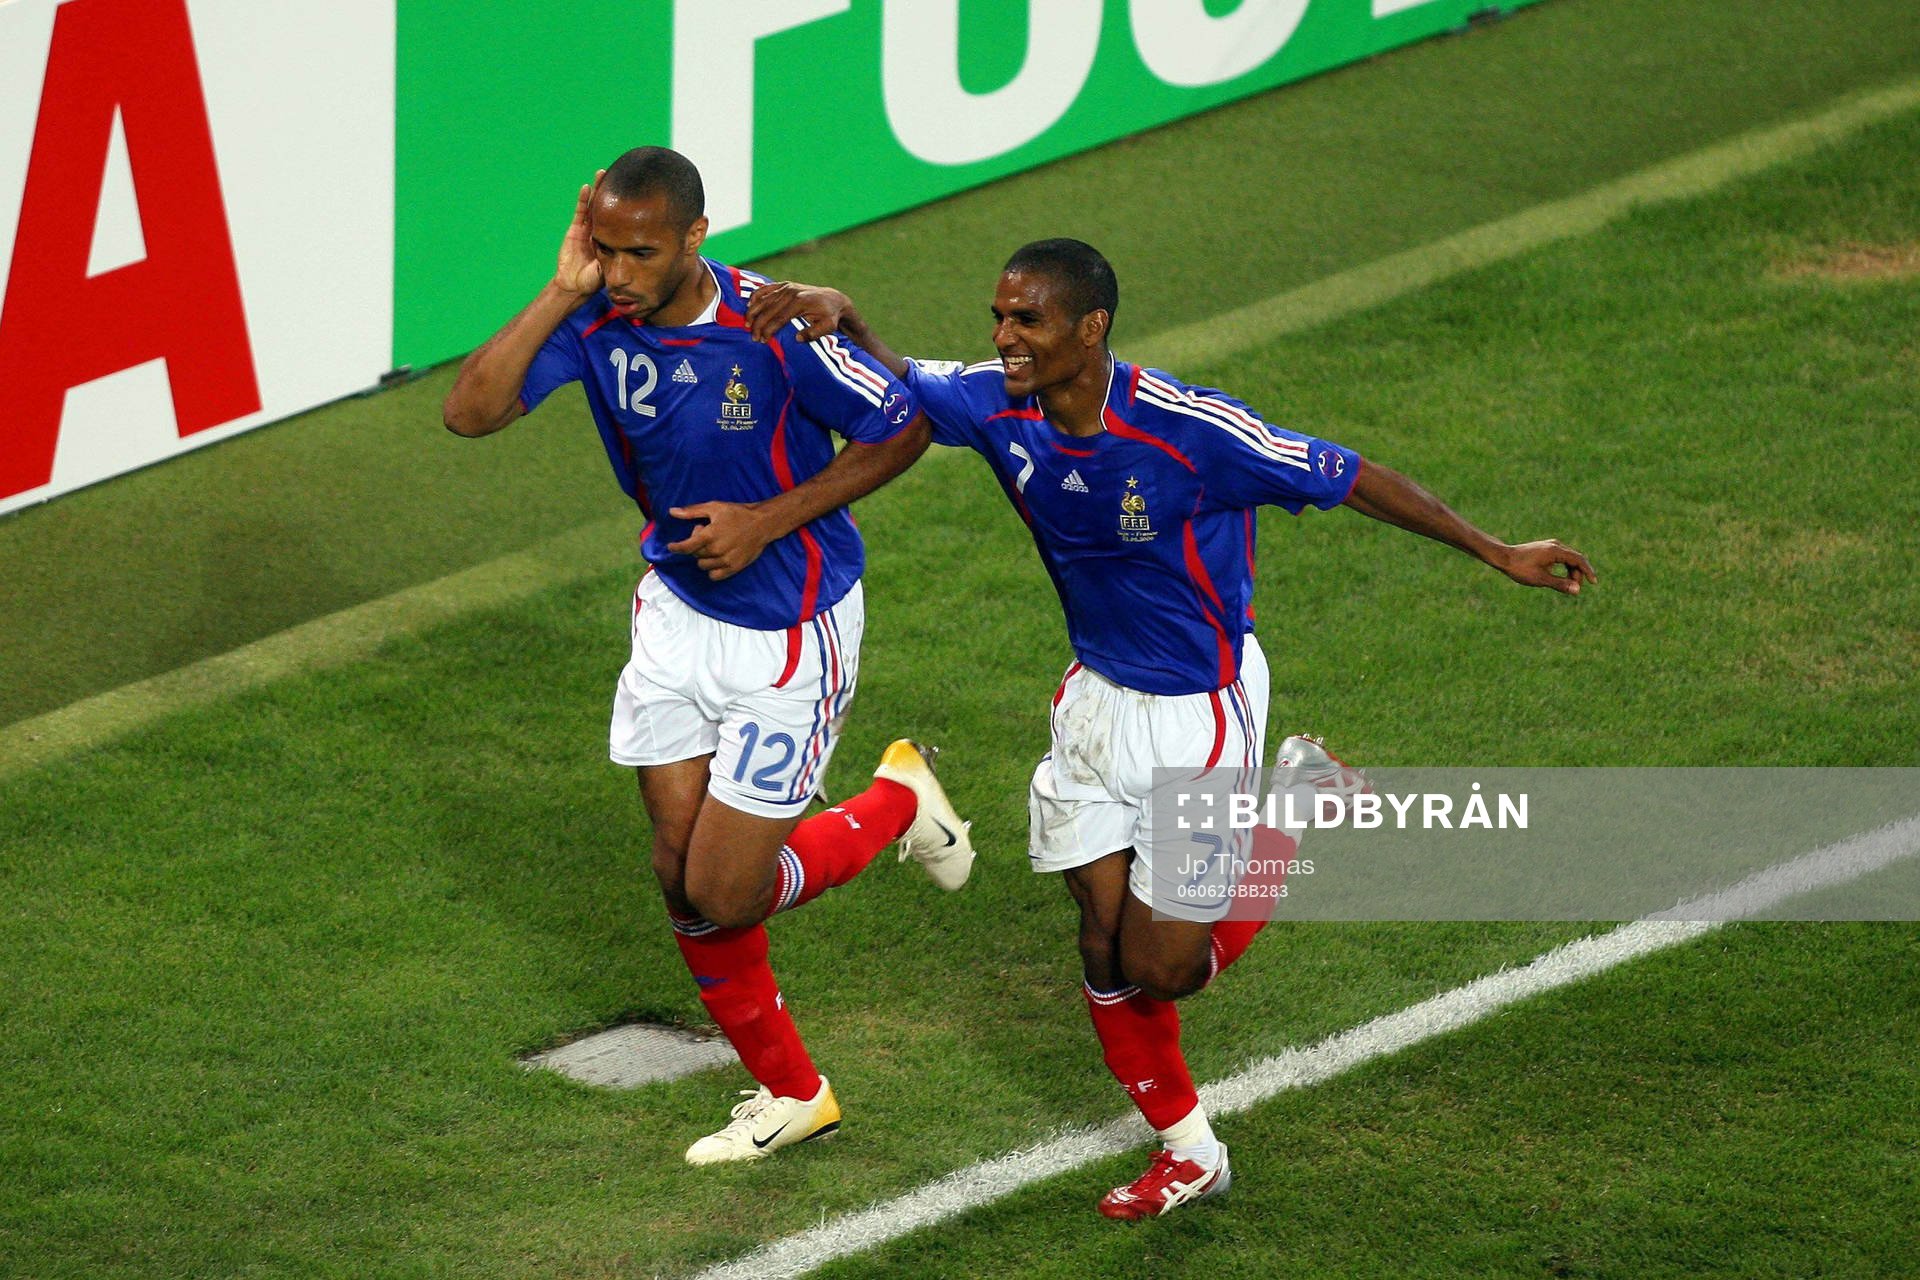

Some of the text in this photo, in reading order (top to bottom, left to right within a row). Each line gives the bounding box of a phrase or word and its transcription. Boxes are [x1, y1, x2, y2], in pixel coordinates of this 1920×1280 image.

[609, 347, 658, 418] 12
[1009, 441, 1035, 495] 7
[733, 721, 796, 792] 12
[1186, 831, 1223, 889] 7
